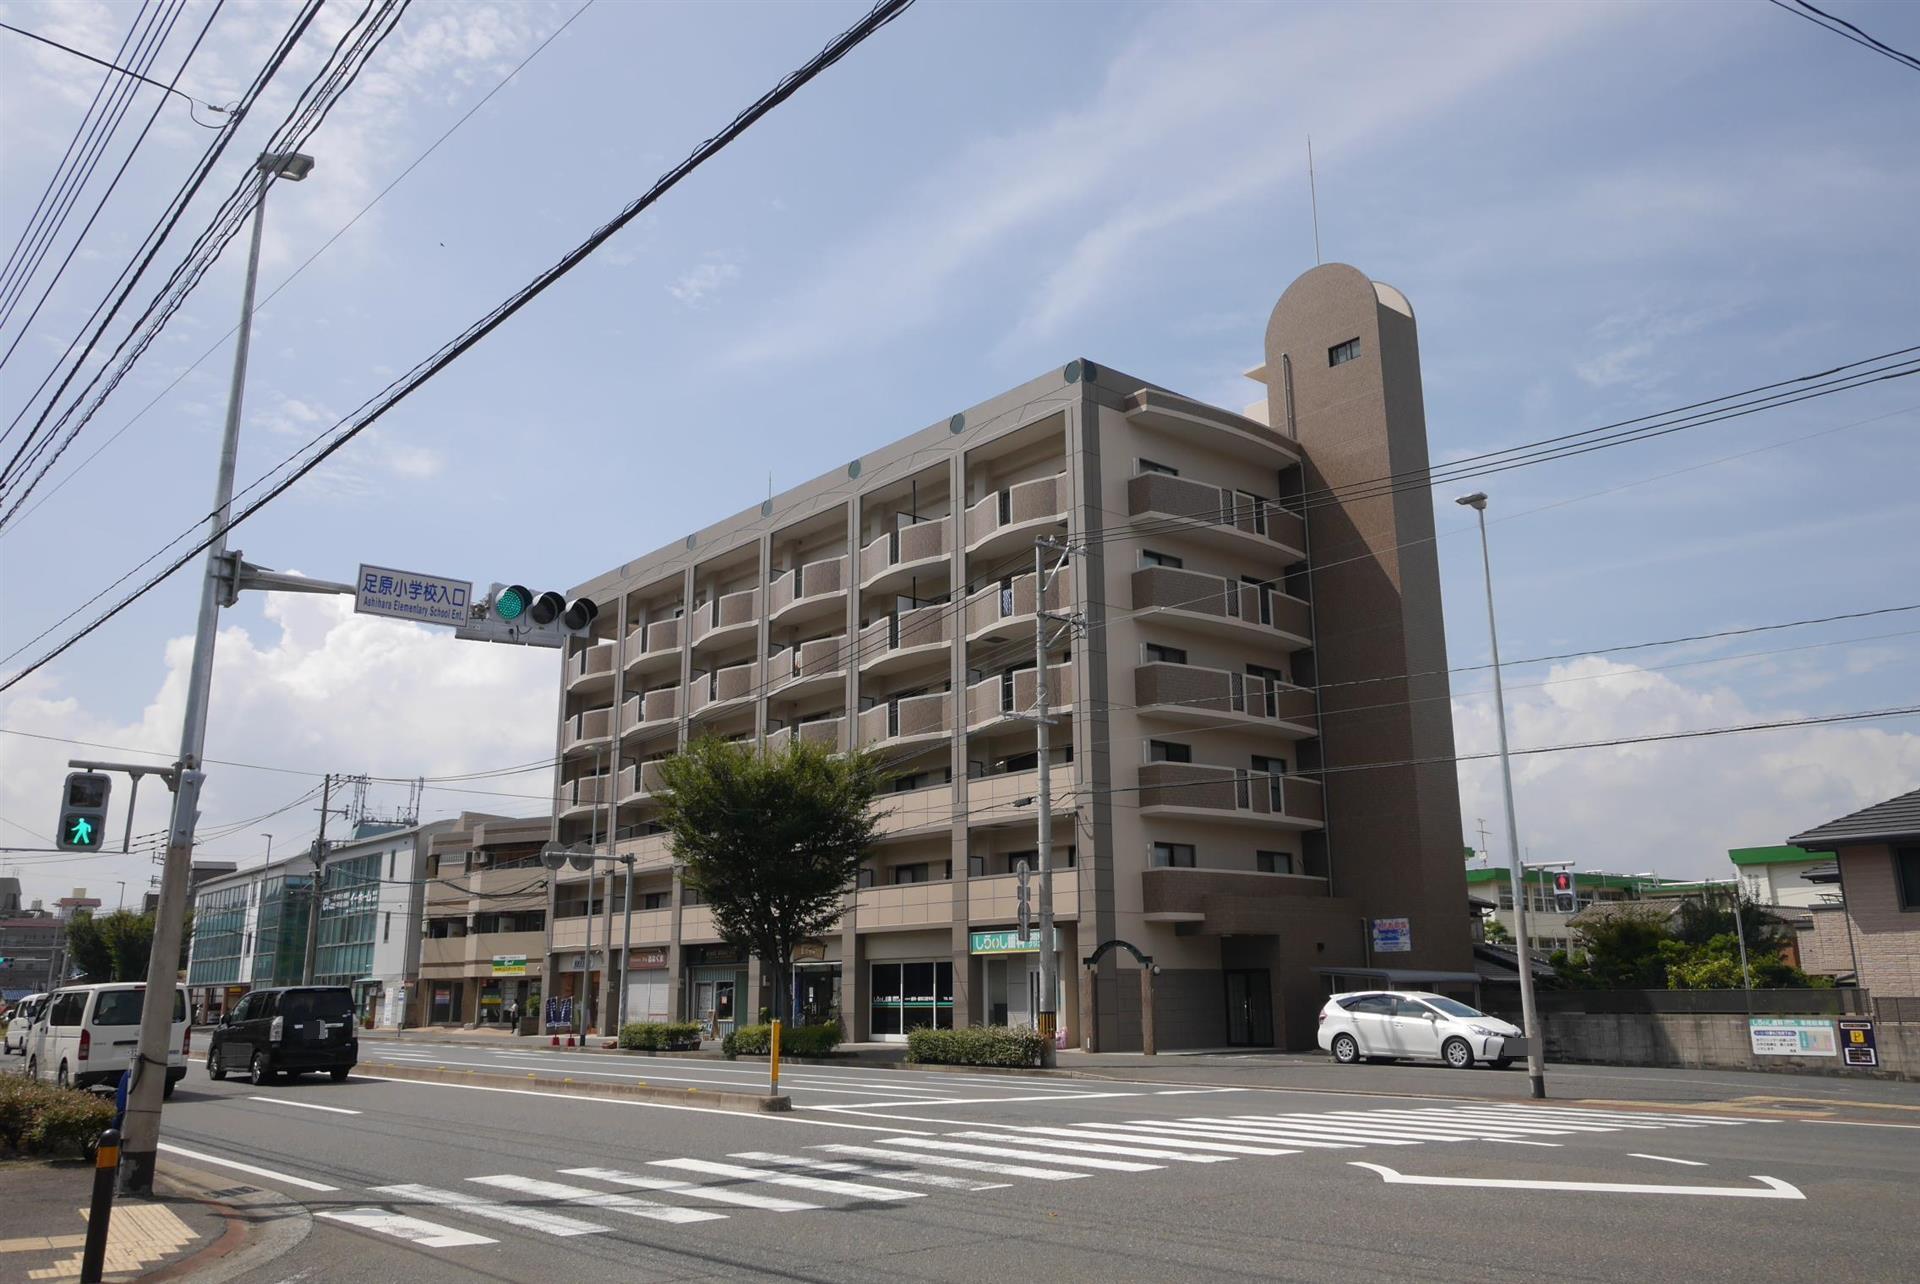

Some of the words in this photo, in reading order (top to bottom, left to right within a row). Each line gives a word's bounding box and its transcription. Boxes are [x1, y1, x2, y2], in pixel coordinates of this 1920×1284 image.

[362, 573, 466, 607] 足原小学校入口
[364, 596, 392, 610] Ashihara
[394, 600, 433, 617] Elementary
[430, 606, 450, 618] School
[451, 608, 464, 621] Ent.
